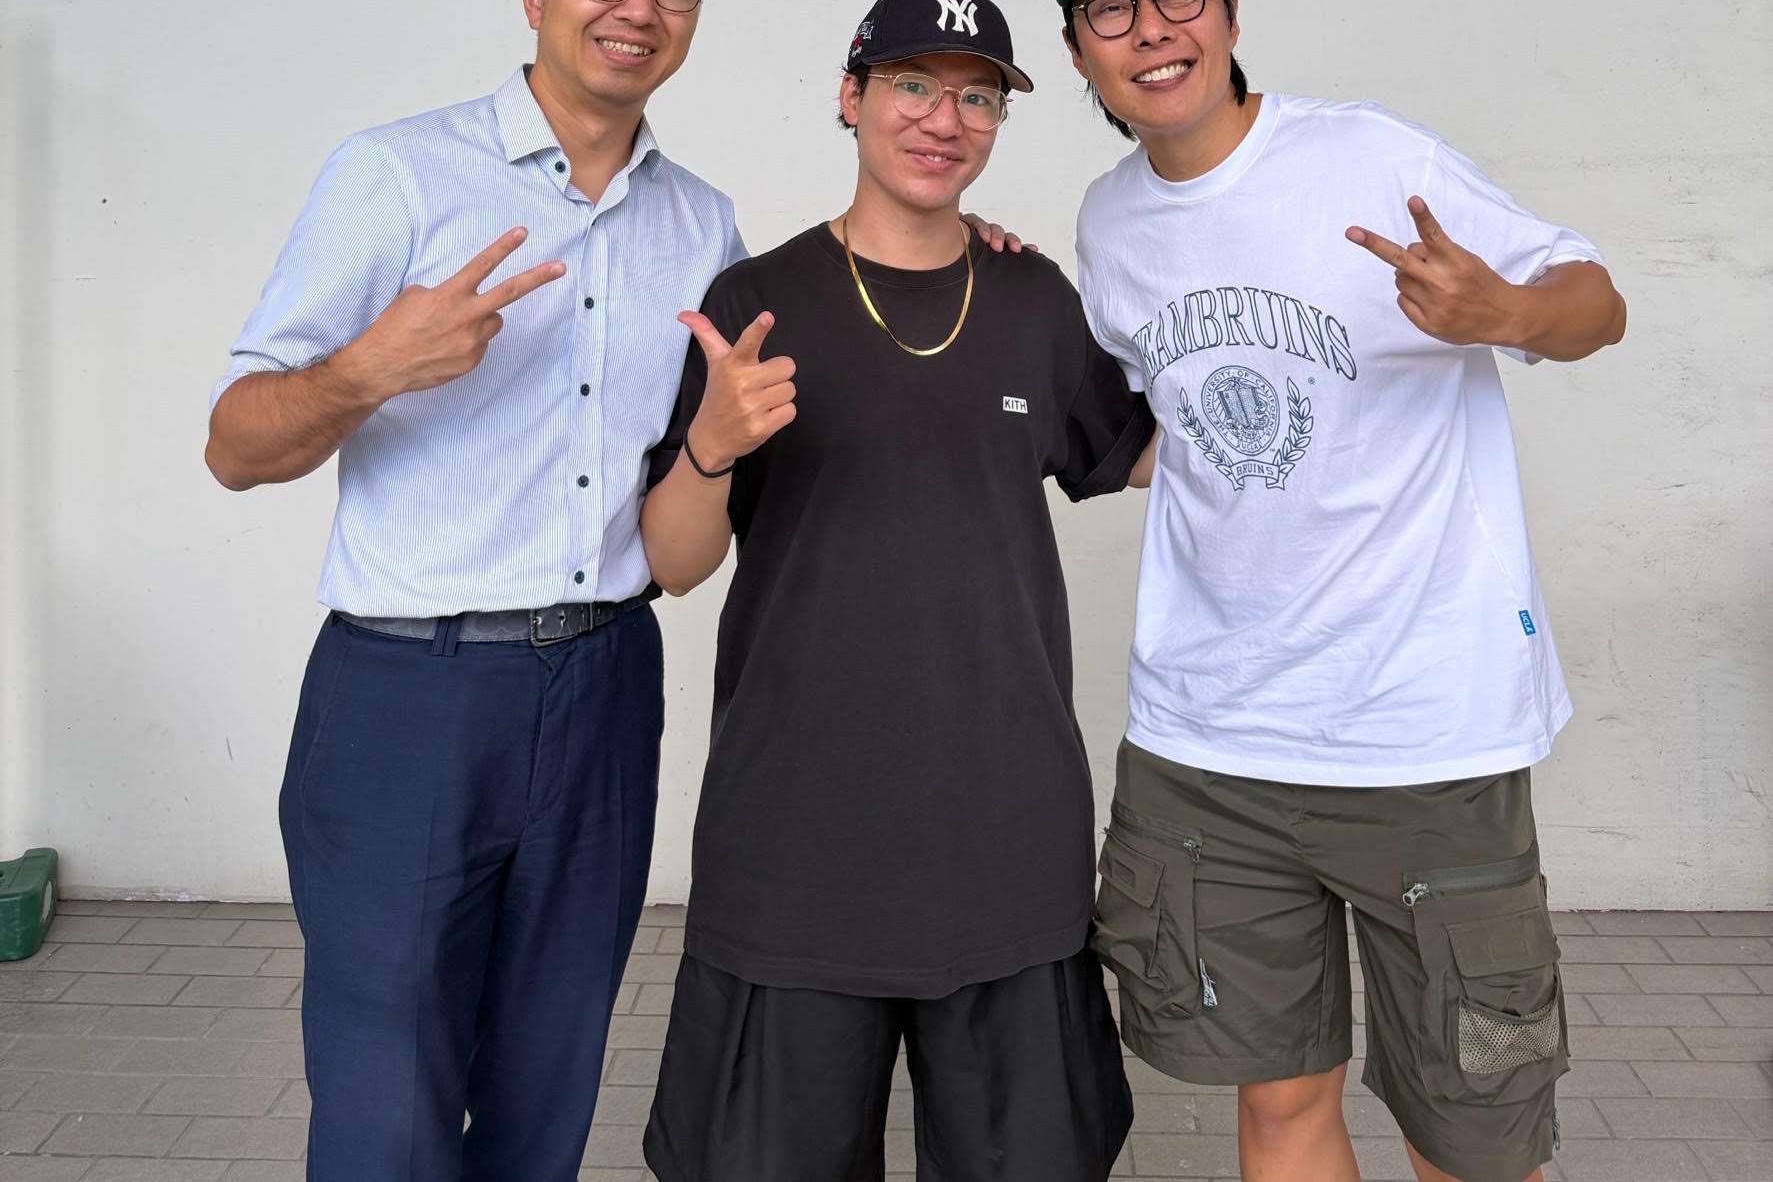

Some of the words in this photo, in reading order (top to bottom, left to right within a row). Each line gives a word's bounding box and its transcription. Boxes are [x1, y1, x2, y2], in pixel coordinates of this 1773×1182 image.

[1004, 398, 1027, 412] KITH
[1205, 370, 1231, 414] UNIVERSITY
[1237, 370, 1249, 378] OF
[1255, 379, 1277, 436] CALIFORNIA
[1236, 462, 1275, 477] BRUINS
